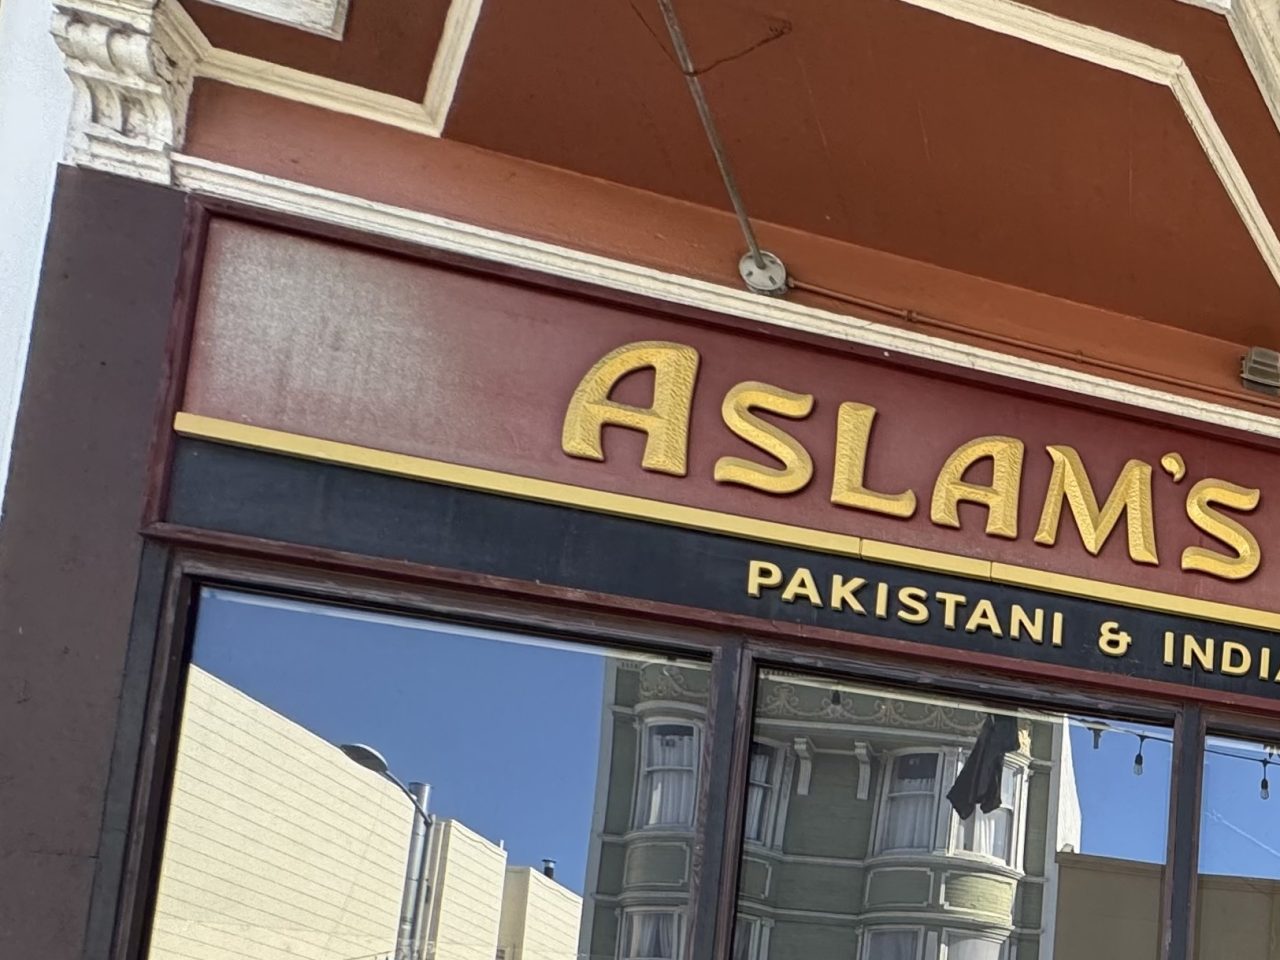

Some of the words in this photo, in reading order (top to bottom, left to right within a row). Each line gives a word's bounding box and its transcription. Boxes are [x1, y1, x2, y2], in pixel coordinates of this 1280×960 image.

[561, 340, 1261, 581] ASLAM'S
[746, 559, 1063, 647] PAKISTANI
[1098, 620, 1132, 656] &
